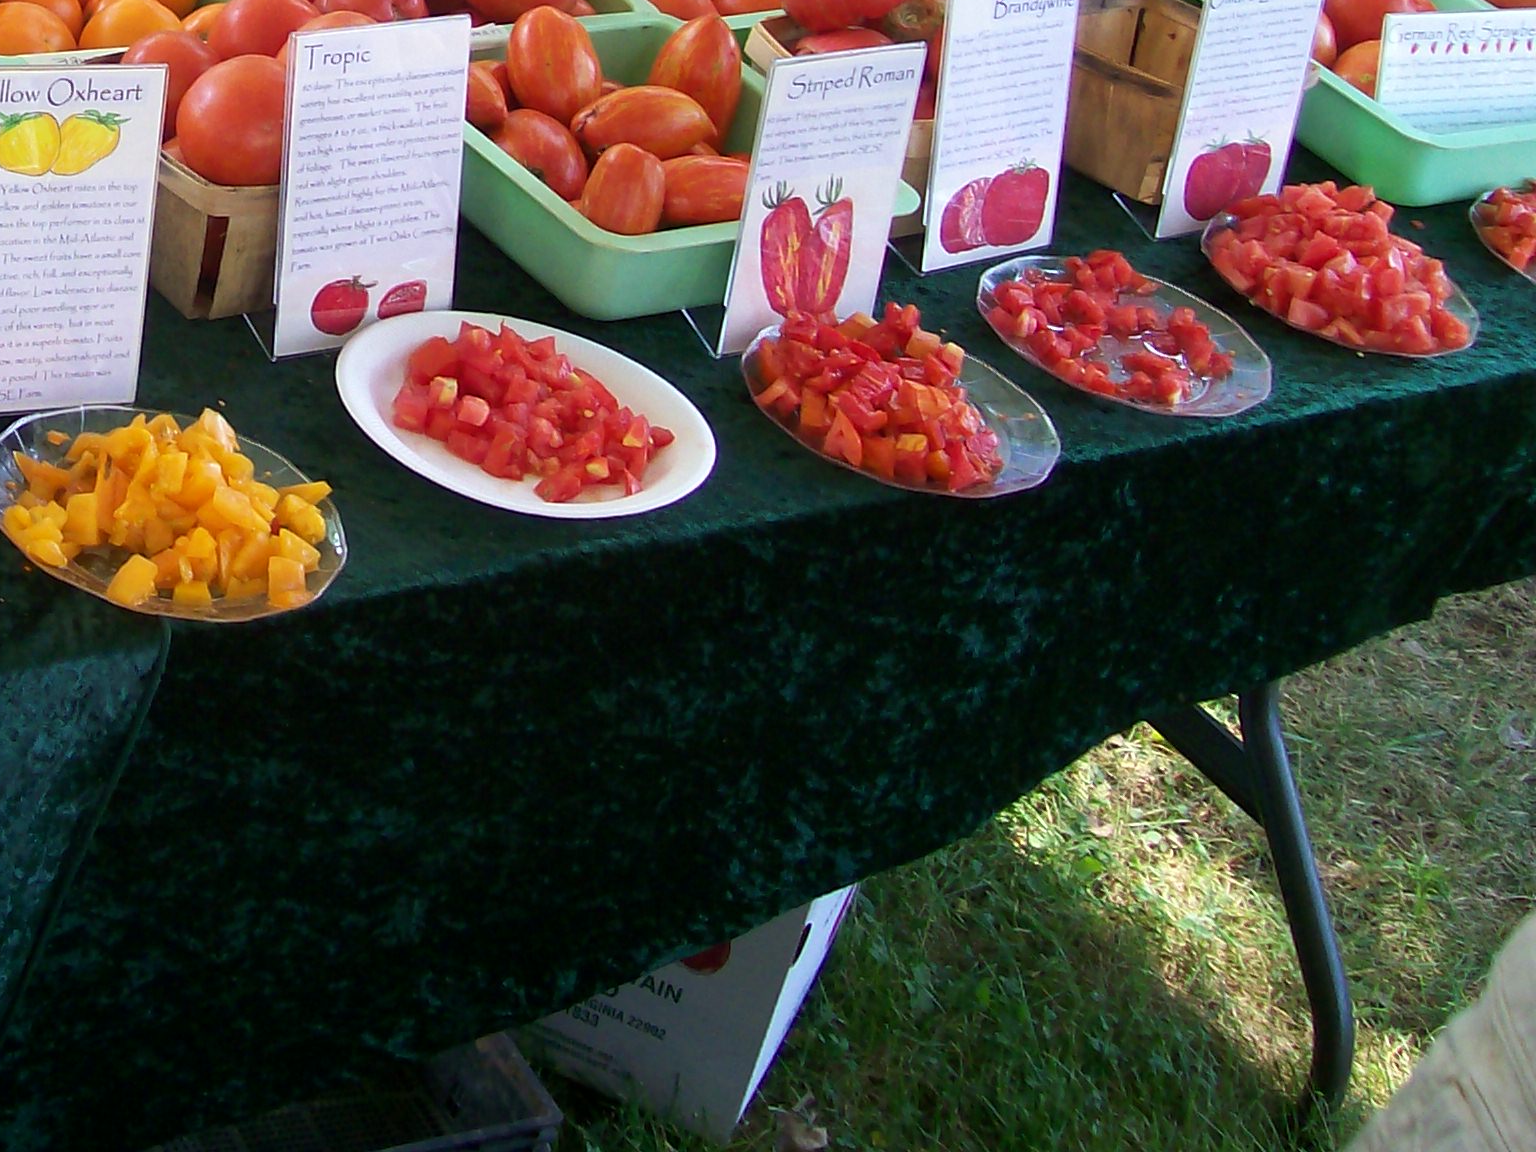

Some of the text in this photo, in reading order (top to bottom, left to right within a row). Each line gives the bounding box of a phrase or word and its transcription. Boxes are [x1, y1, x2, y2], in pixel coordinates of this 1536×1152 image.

[1388, 24, 1443, 44] German
[1446, 23, 1475, 42] Red
[305, 44, 372, 74] Tropic
[48, 78, 144, 106] Oxheart
[788, 65, 914, 100] Striped Roman
[637, 975, 683, 1004] AIN
